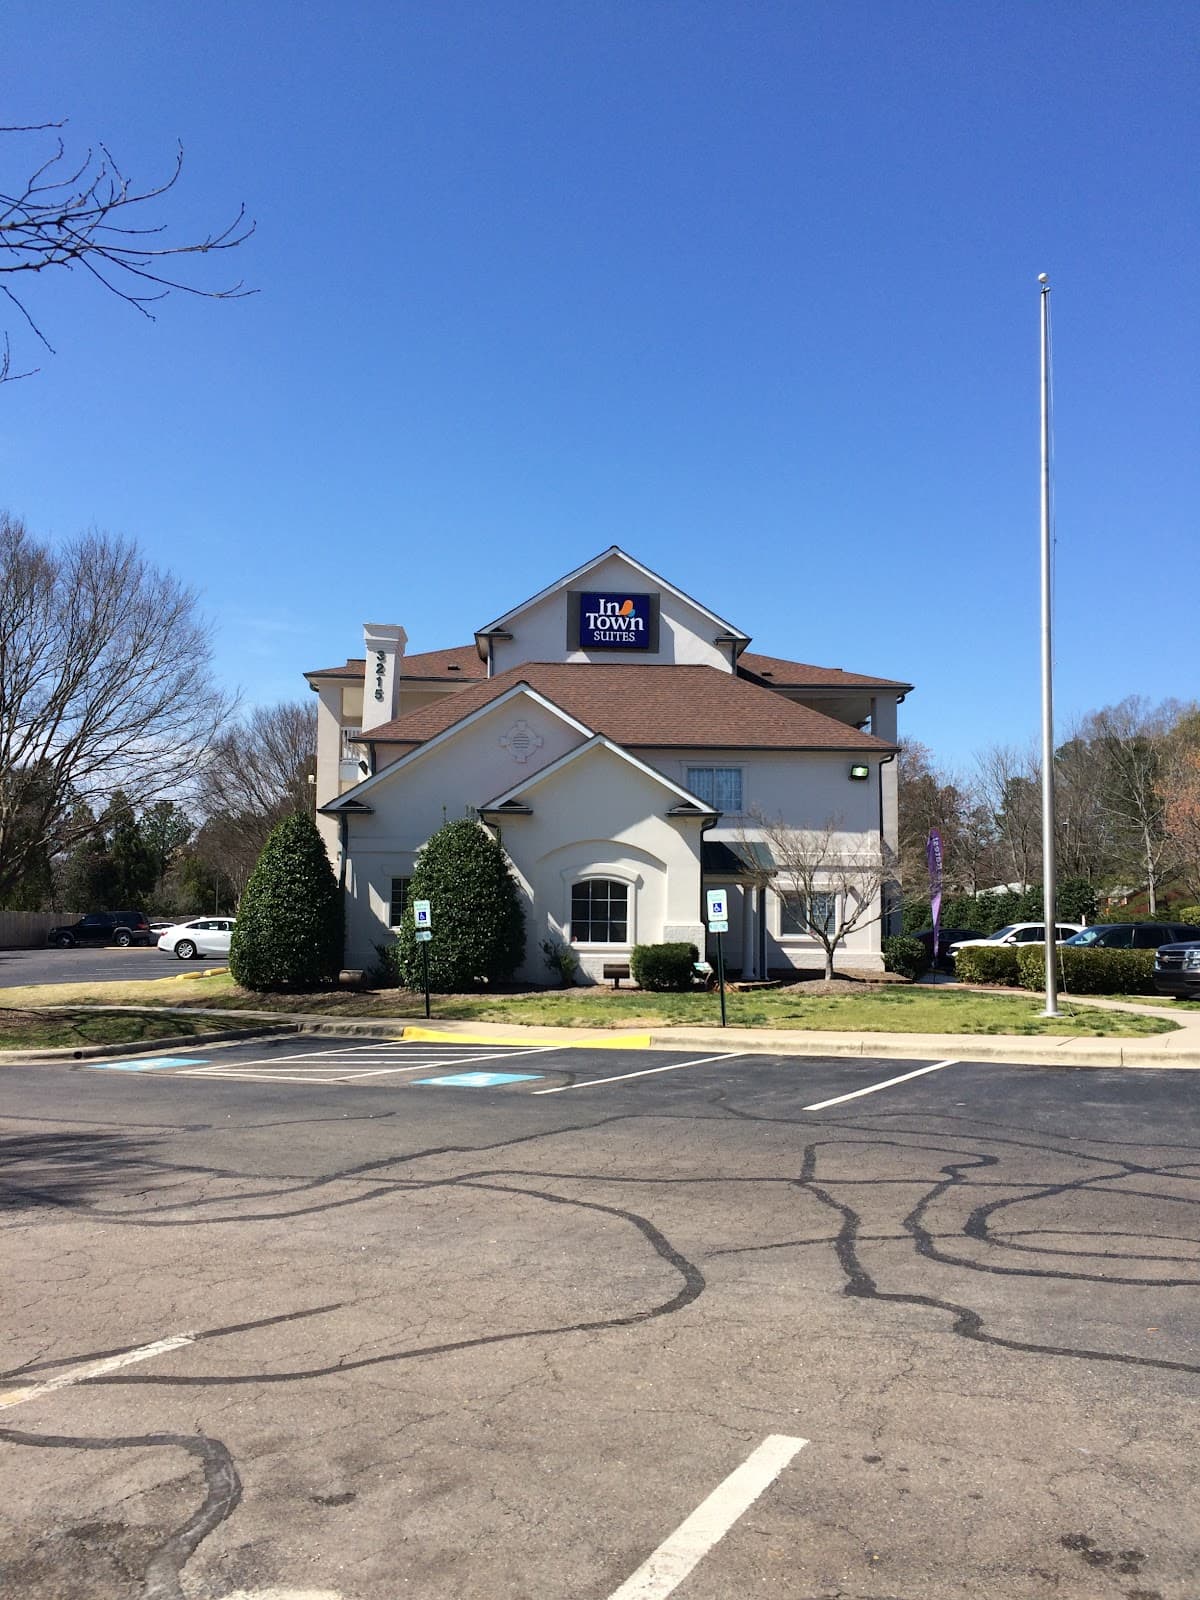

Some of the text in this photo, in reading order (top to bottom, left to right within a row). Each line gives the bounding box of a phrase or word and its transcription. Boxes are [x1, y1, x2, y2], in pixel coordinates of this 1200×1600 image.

[599, 599, 620, 615] In
[593, 631, 635, 642] SUITES
[374, 650, 385, 700] 3215
